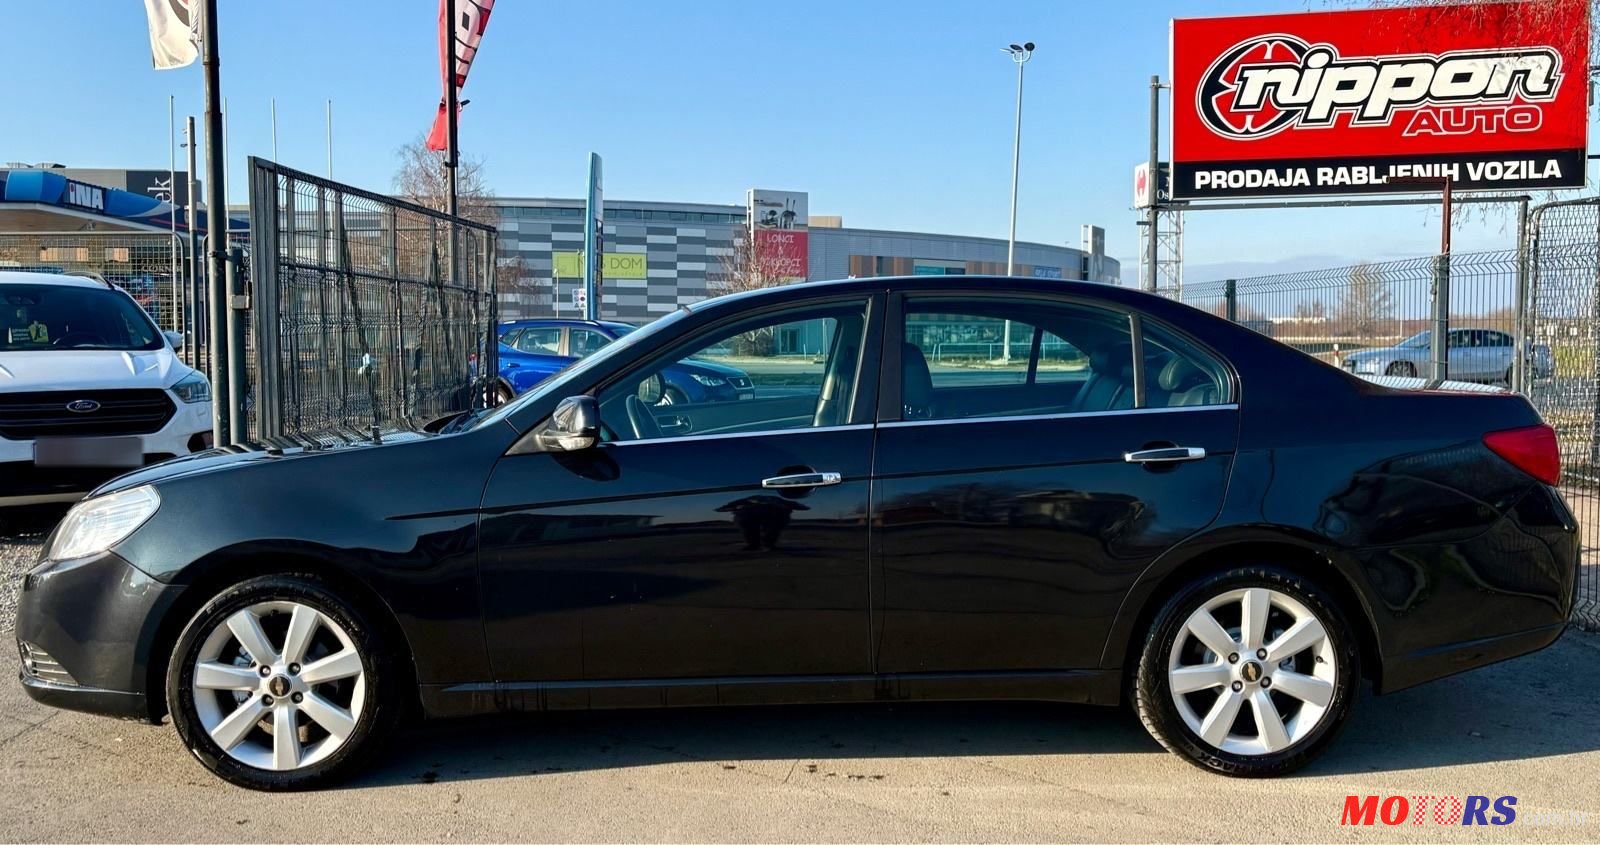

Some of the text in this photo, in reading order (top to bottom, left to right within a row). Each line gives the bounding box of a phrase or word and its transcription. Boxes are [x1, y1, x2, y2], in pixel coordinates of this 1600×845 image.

[1232, 46, 1561, 127] nippon
[1402, 105, 1542, 137] AUTO
[1195, 167, 1308, 190] PRODAJA
[1465, 159, 1562, 181] VOZILA
[141, 264, 182, 273] CORNR
[610, 257, 643, 270] DOM
